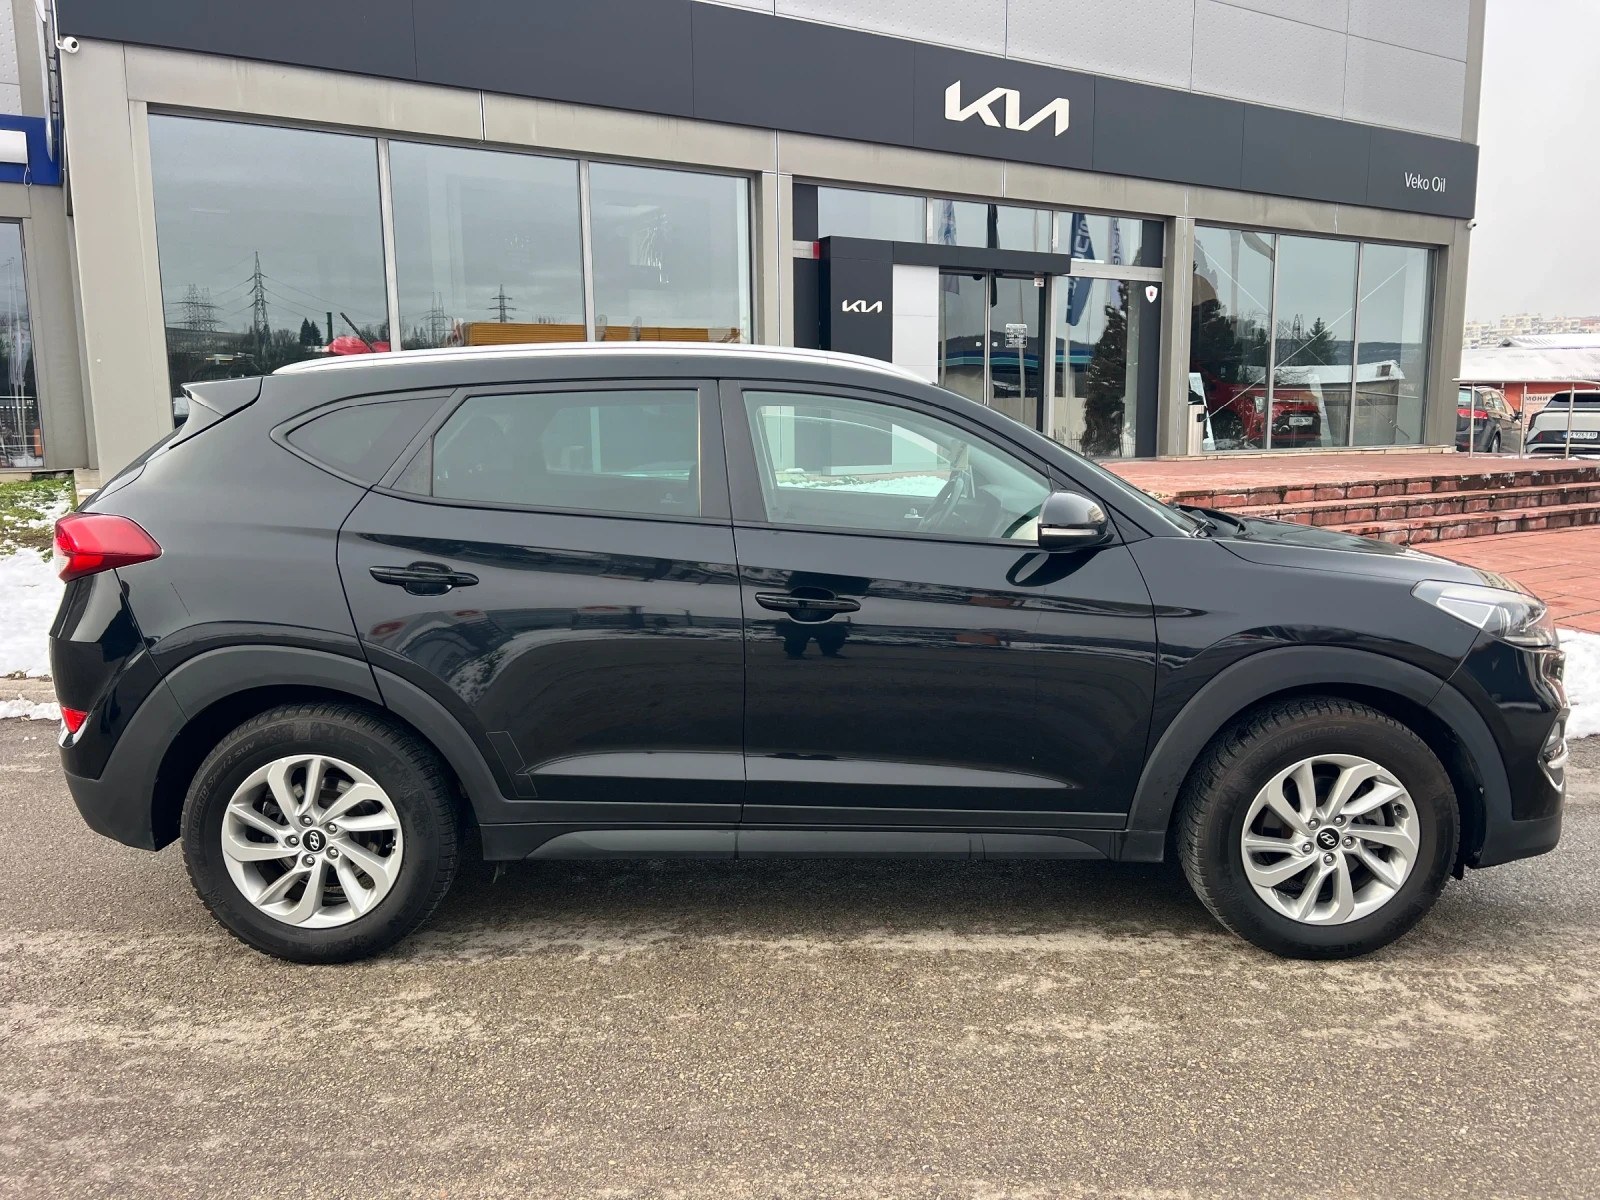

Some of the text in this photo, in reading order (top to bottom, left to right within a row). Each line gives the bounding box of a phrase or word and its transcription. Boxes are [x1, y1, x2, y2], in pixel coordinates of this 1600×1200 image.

[945, 80, 1070, 137] KIA
[1404, 171, 1446, 192] Veko Oil
[842, 299, 883, 313] KIA
[234, 742, 255, 758] SUV
